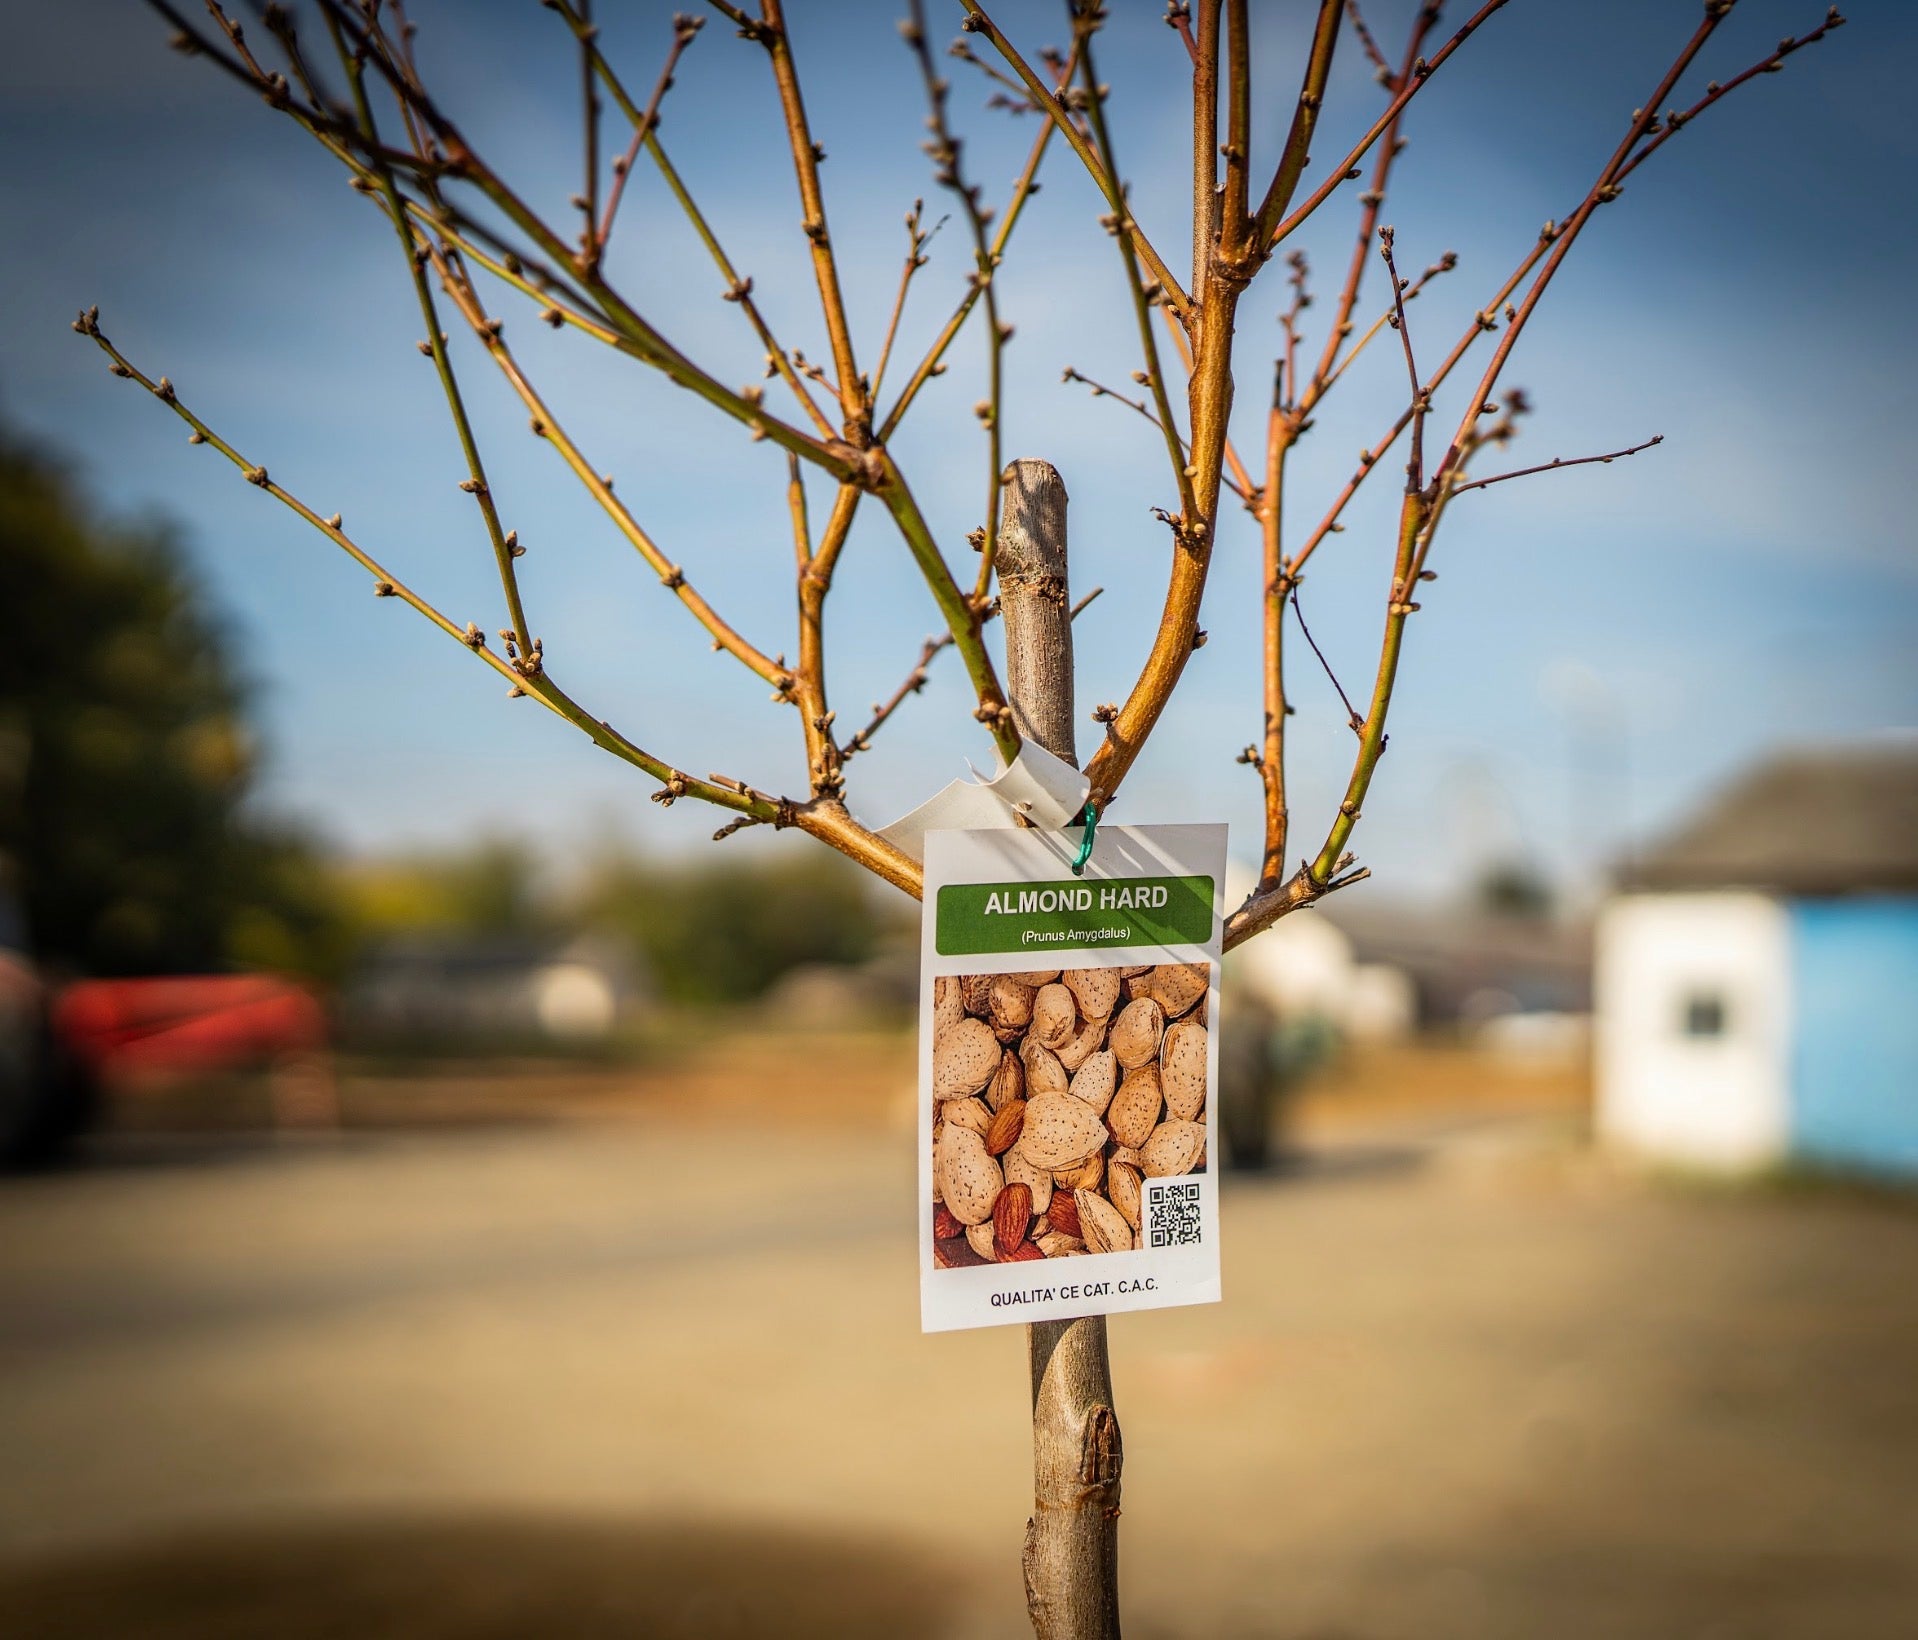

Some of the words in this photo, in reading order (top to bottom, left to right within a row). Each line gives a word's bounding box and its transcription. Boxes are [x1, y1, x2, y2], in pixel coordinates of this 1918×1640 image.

[984, 889, 1093, 915] ALMOND
[1100, 886, 1168, 910] HARD
[1021, 930, 1065, 945] (Prunus
[1066, 926, 1131, 943] Amygdalus)
[990, 1288, 1056, 1307] QUALITA'
[1060, 1285, 1080, 1300] CE
[1083, 1282, 1114, 1297] CAT.
[1118, 1277, 1159, 1294] C.A.C.
